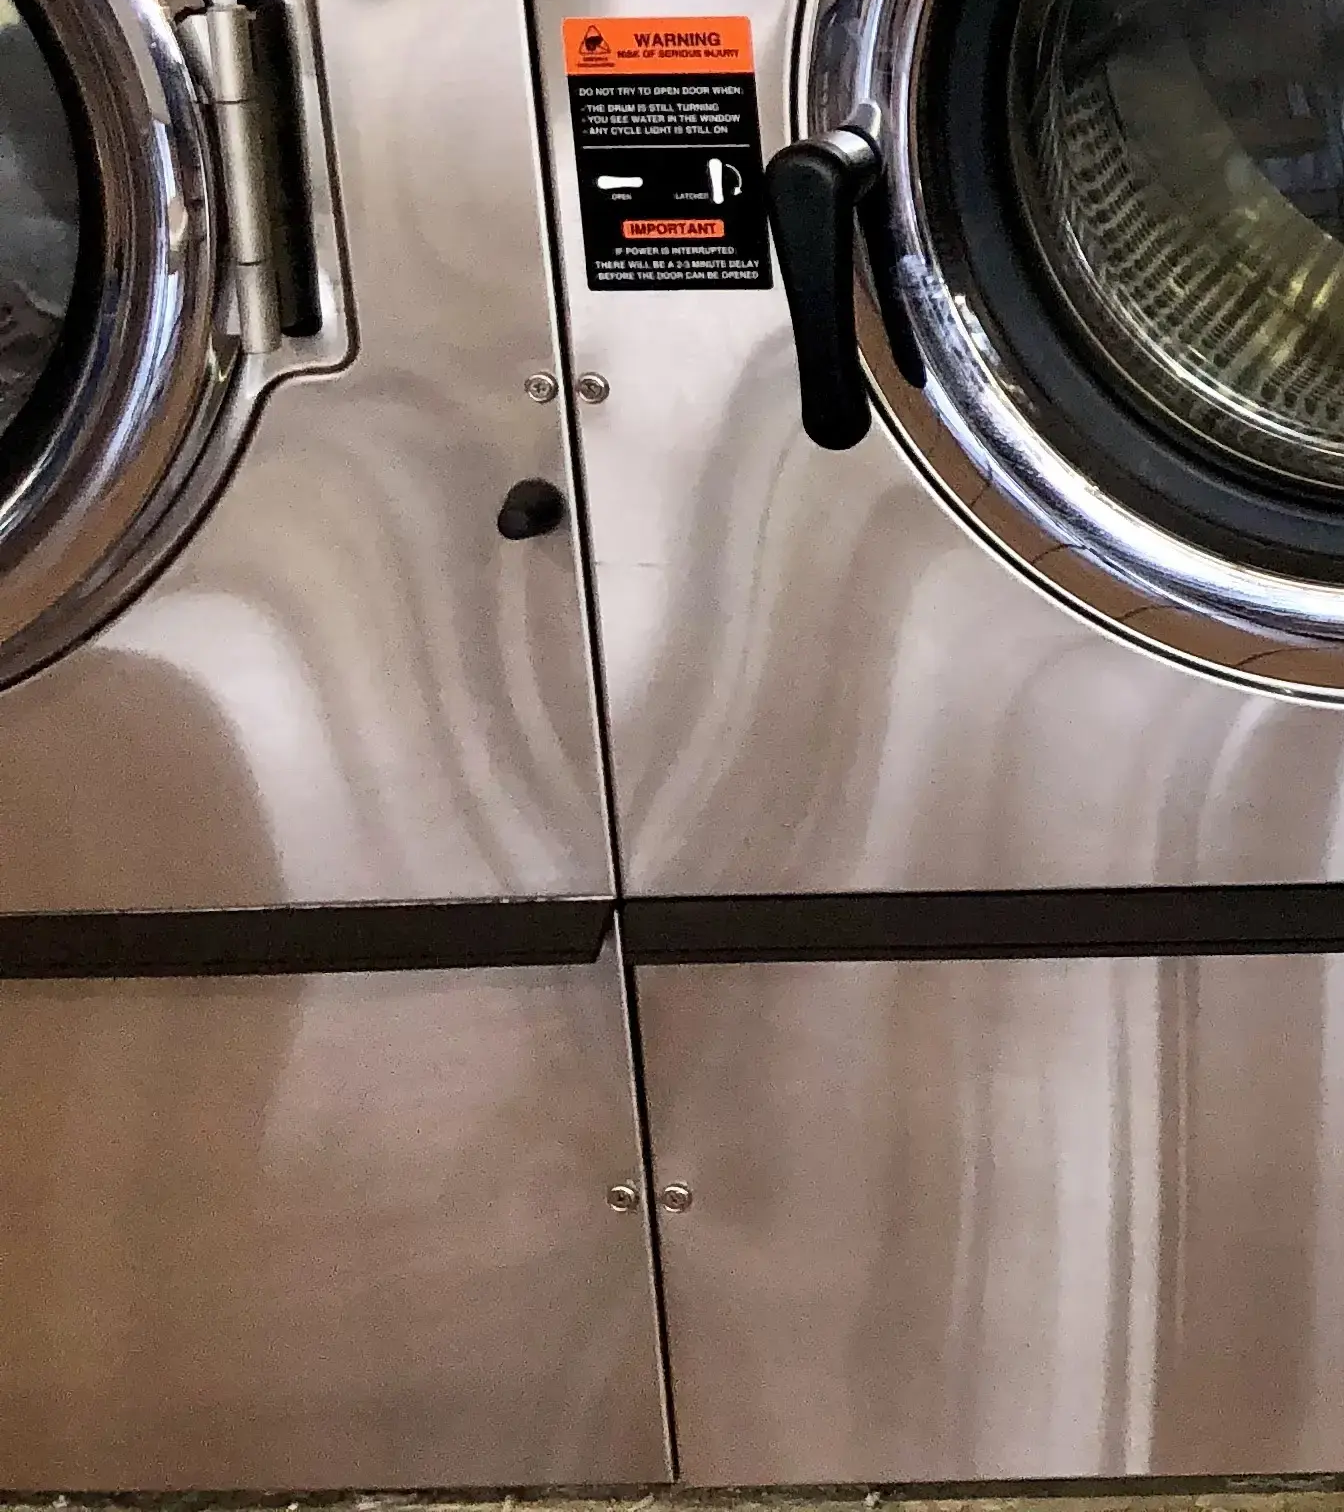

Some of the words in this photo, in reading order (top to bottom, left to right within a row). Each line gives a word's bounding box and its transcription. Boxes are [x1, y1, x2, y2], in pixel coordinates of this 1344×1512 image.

[634, 32, 721, 47] WARNING
[643, 49, 655, 58] OF
[658, 49, 702, 59] SERIOUS
[578, 88, 593, 96] DO
[595, 87, 614, 96] NOT
[617, 87, 636, 95] TRY
[639, 87, 650, 95] TO
[653, 87, 680, 96] OPEN
[682, 86, 710, 95] DOOR
[586, 104, 605, 113] THE
[607, 104, 635, 113] DRUM
[637, 104, 647, 112] IS
[648, 103, 674, 112] STILL
[588, 115, 608, 124] YOU
[610, 115, 629, 124] SEE
[631, 114, 665, 123] WATER
[667, 114, 677, 123] IN
[679, 114, 697, 123] THE
[700, 114, 740, 123] WINDOW
[589, 126, 608, 135] ANY
[611, 126, 641, 135] CYCLE
[644, 125, 672, 134] LIGHT
[685, 125, 712, 134] STILL
[713, 125, 728, 134] ON
[630, 223, 716, 235] IMPORTANT
[625, 247, 659, 255] POWER
[595, 260, 625, 269] THERE
[667, 260, 675, 268] A
[656, 272, 683, 280] DOOR
